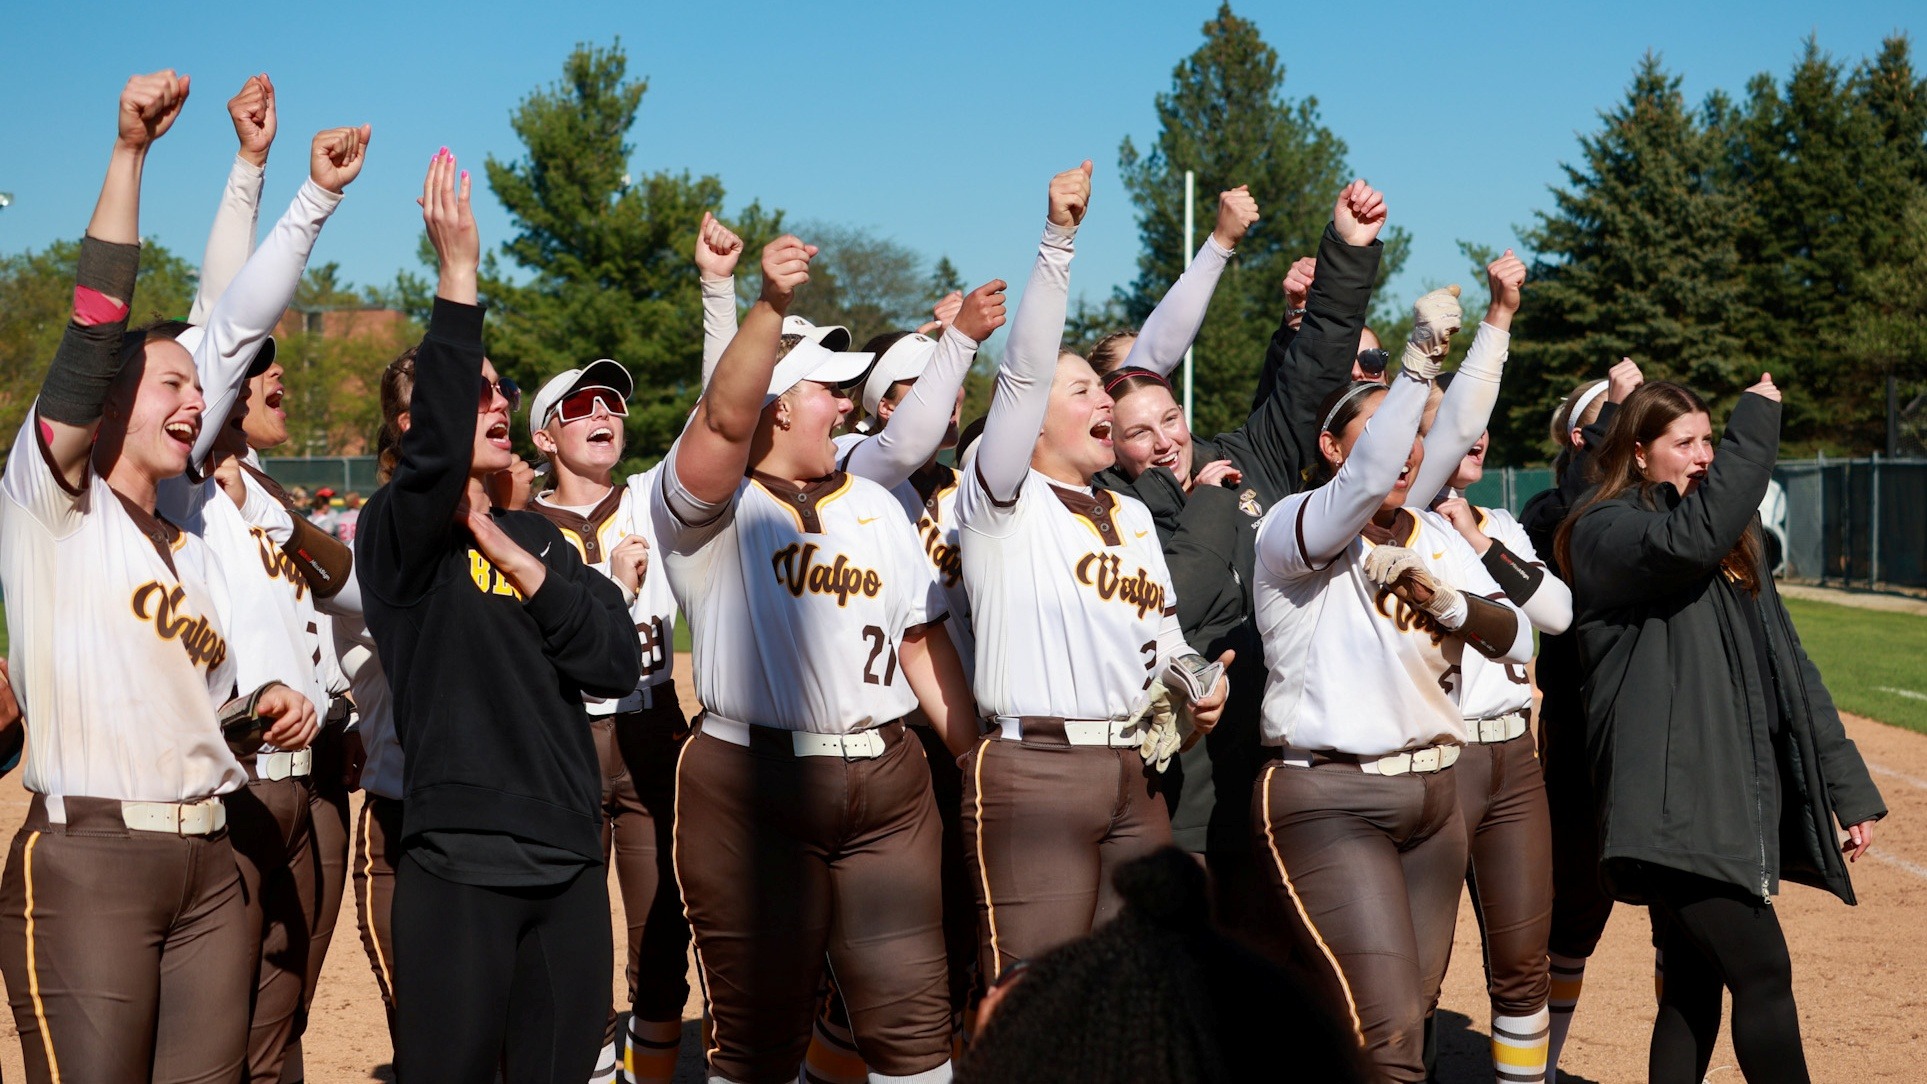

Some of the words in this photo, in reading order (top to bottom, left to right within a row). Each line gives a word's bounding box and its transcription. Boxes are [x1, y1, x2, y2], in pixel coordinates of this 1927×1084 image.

[771, 541, 883, 608] Valpo
[1076, 551, 1165, 620] Valpo
[129, 579, 227, 672] Valpo
[862, 625, 897, 687] 21
